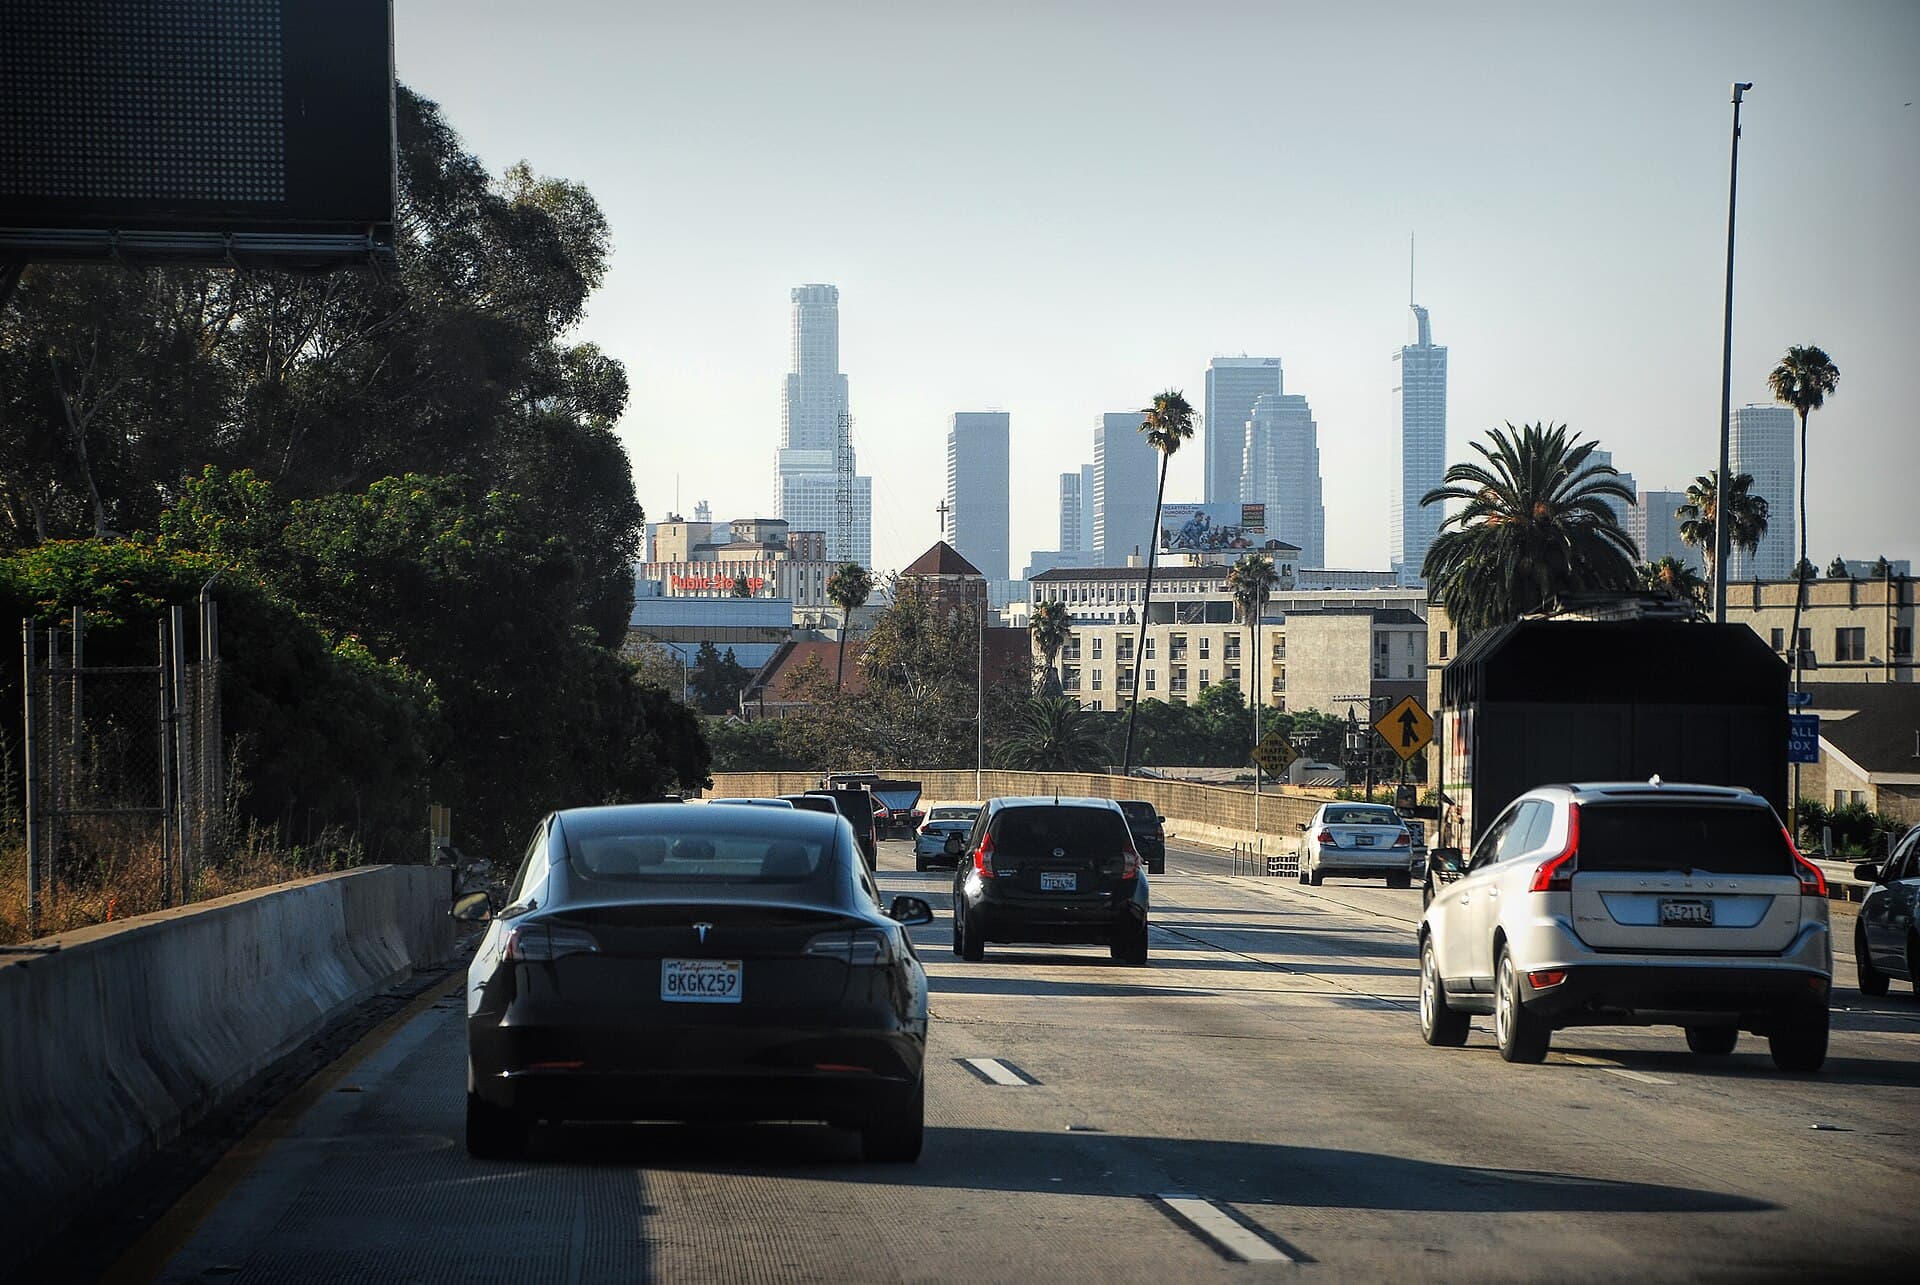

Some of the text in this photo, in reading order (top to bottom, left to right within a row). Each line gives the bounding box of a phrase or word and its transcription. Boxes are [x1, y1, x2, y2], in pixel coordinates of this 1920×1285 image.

[671, 574, 764, 594] Public Stoge
[1791, 727, 1816, 737] ALL
[667, 973, 737, 993] 8KGK259
